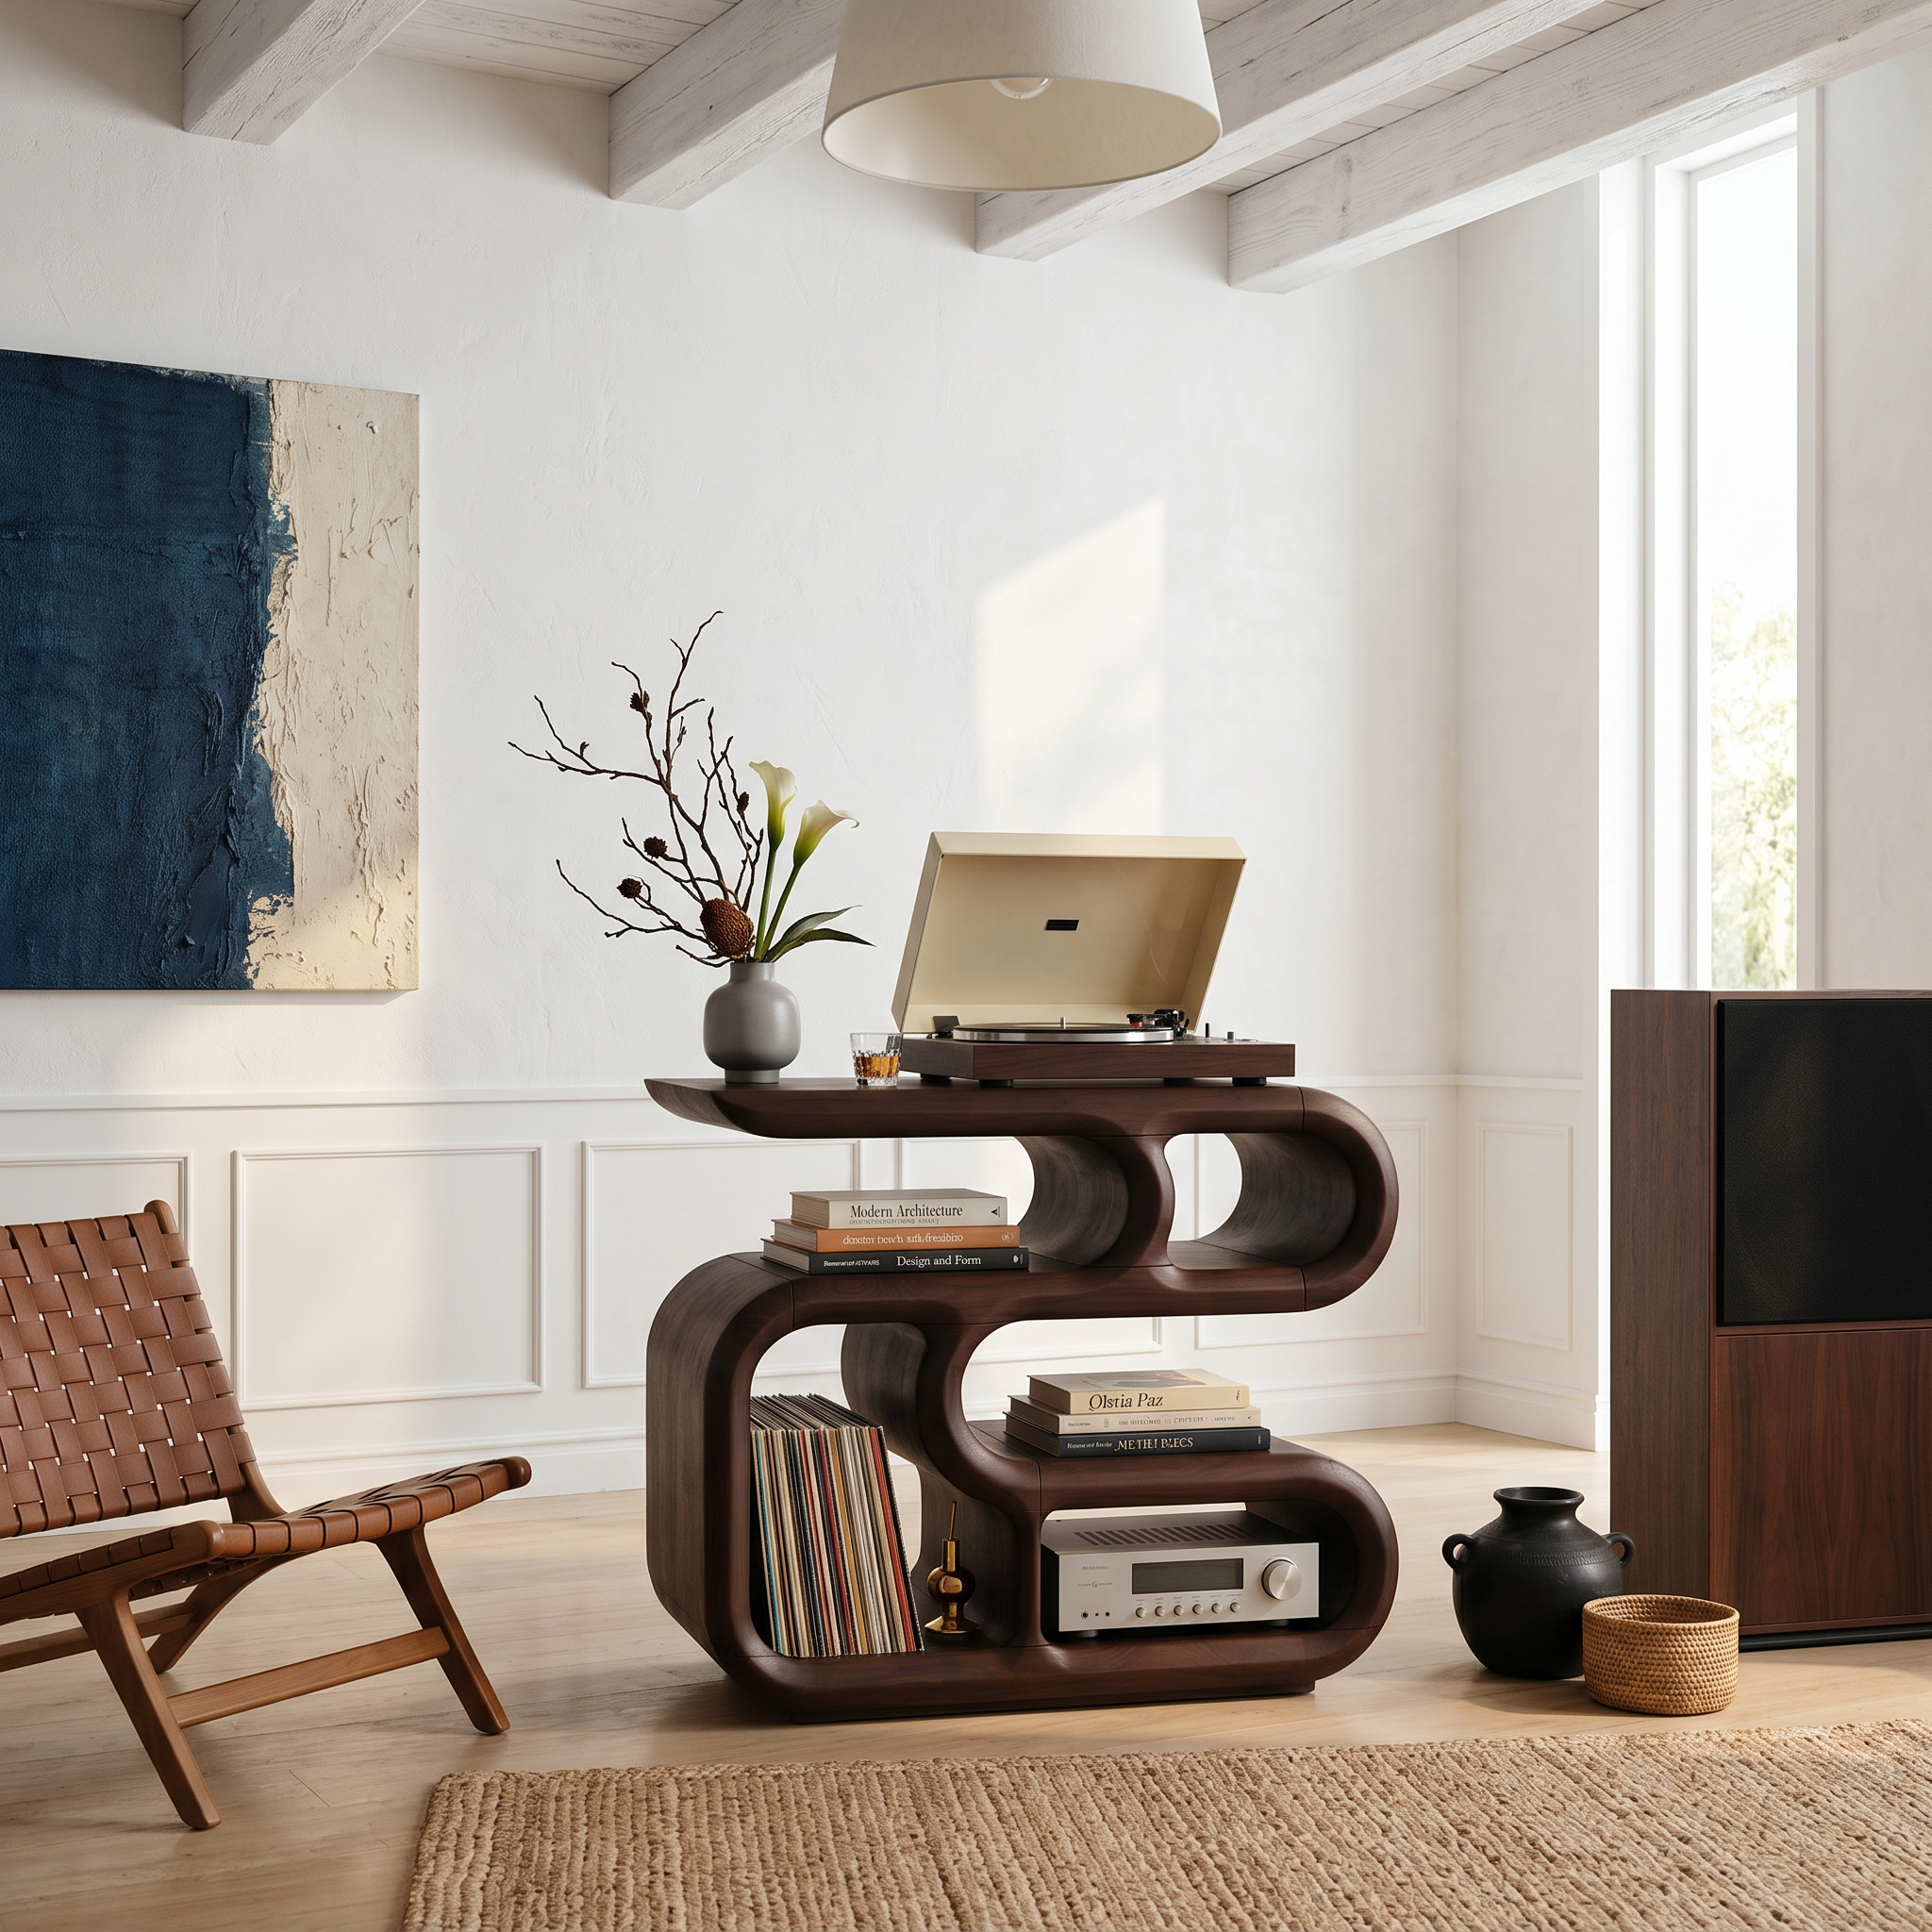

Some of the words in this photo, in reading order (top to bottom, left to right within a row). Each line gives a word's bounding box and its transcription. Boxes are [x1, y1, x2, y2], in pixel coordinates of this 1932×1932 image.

[850, 1204, 892, 1219] Modern
[897, 1203, 963, 1217] Architecture
[895, 1256, 931, 1269] Design
[933, 1255, 952, 1265] and
[954, 1255, 982, 1265] Form
[1137, 1392, 1163, 1407] Paz
